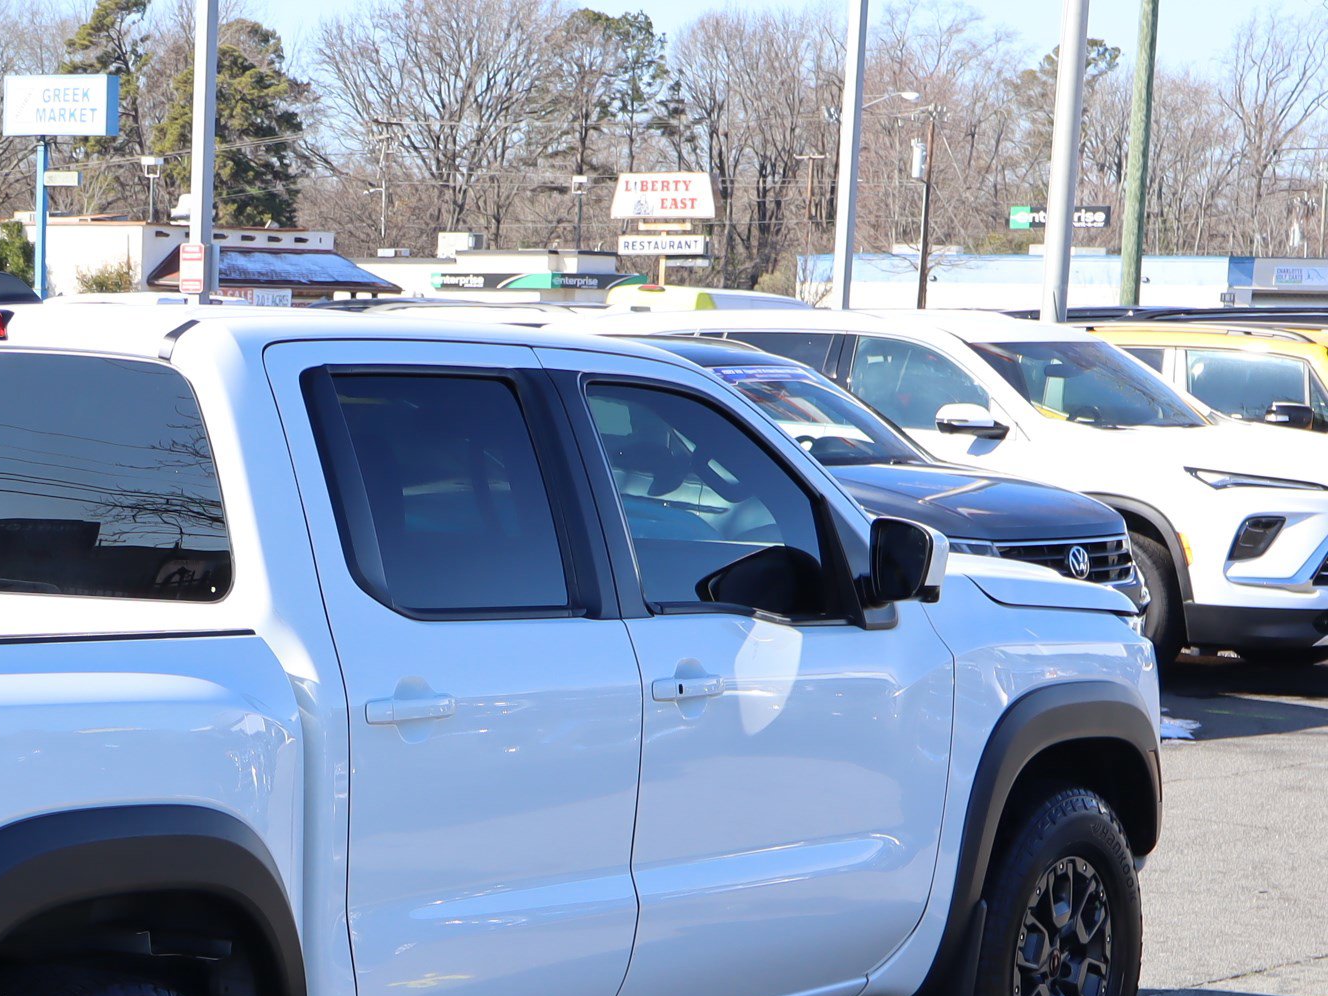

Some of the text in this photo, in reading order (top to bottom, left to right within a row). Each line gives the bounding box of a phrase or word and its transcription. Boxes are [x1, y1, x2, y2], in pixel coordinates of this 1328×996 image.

[42, 87, 91, 103] GREEK
[35, 107, 98, 123] MARKET
[624, 180, 692, 192] LIBERTY
[660, 198, 697, 209] EAST
[623, 240, 699, 251] RESTAURANT
[431, 274, 485, 288] enterprise
[551, 275, 598, 290] enterprise
